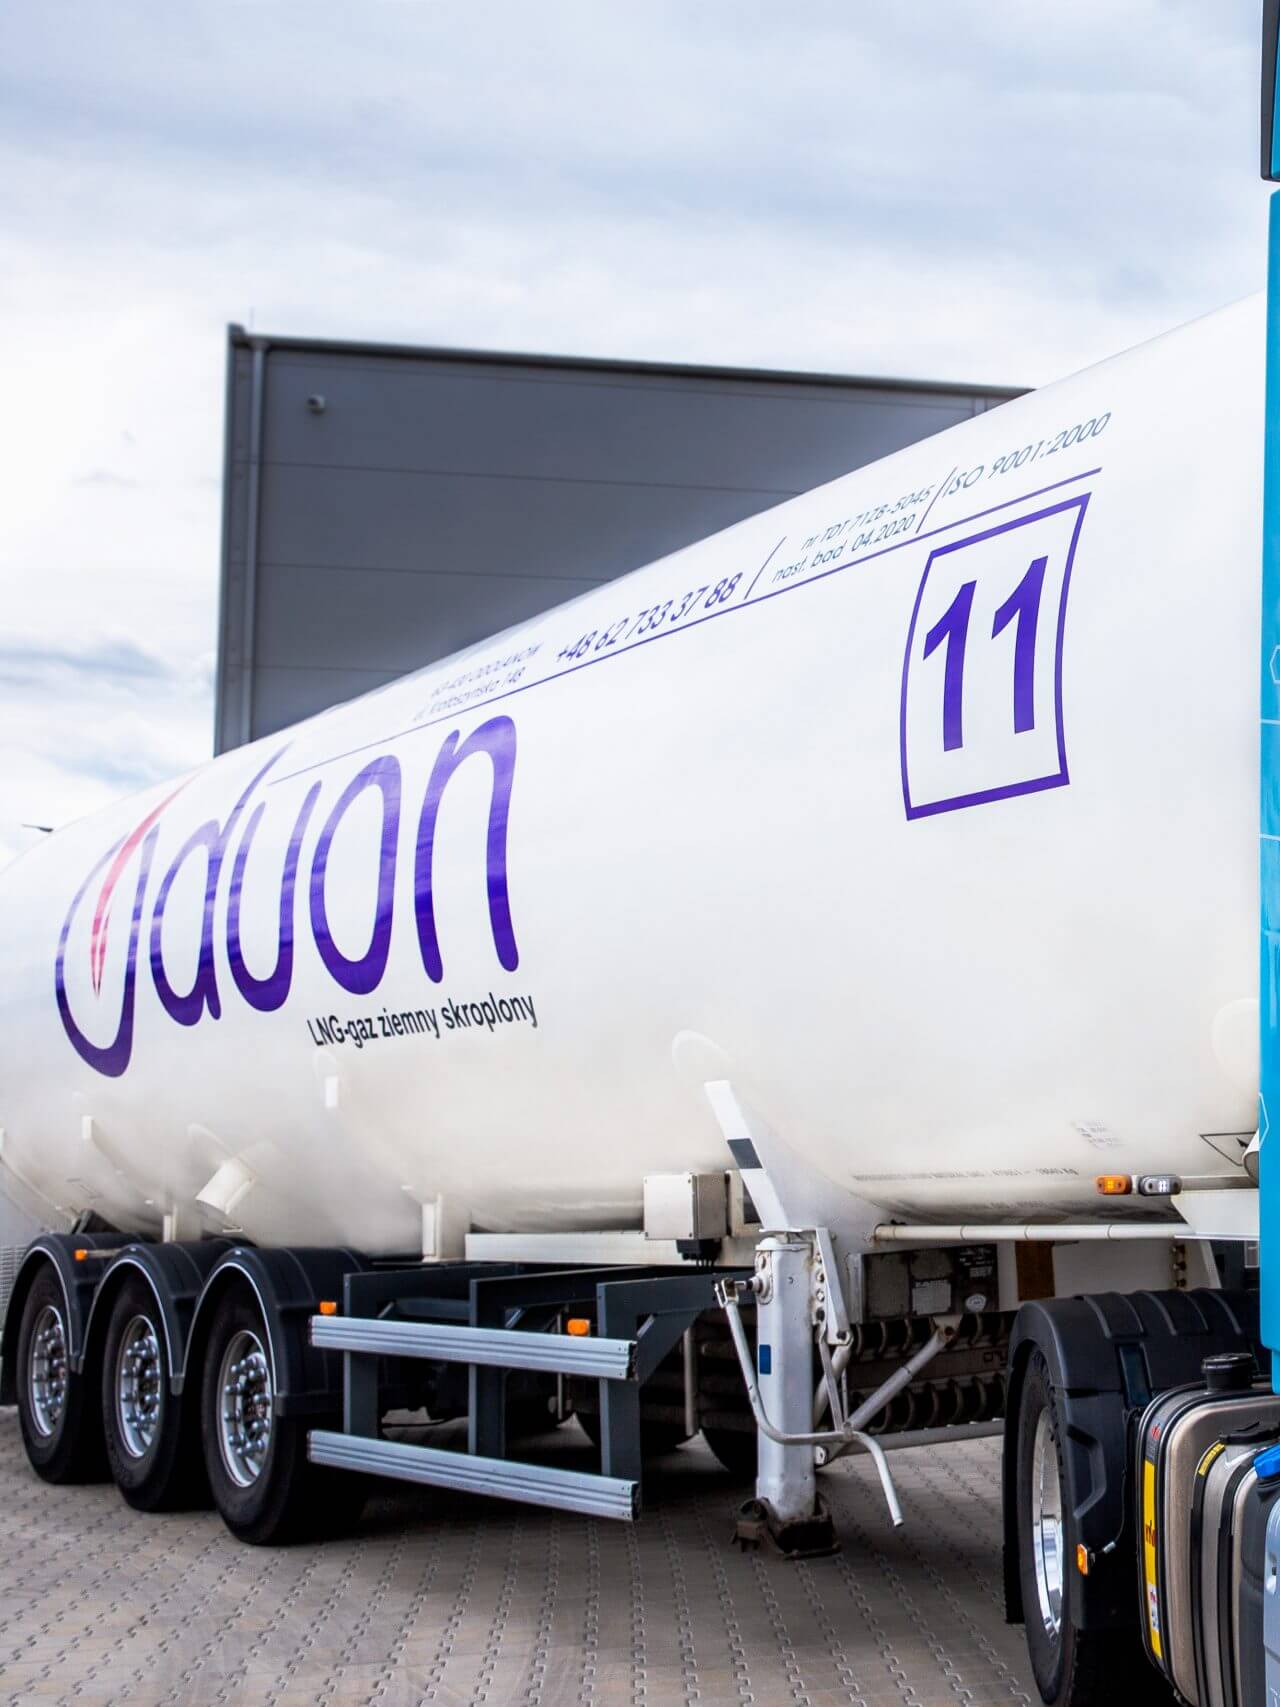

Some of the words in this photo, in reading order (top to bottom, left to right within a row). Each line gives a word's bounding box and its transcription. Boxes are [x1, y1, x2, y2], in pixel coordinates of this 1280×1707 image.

[942, 465, 984, 498] ISO
[988, 411, 1112, 479] 9001:2000
[851, 513, 916, 551] 04.2020
[556, 630, 598, 662] +48
[594, 616, 629, 650] 62
[625, 600, 673, 640] 733
[670, 585, 709, 621] 37
[704, 572, 743, 608] 88
[923, 555, 1049, 752] 11
[307, 1015, 379, 1048] LNG-gaz
[377, 1008, 440, 1039] ziemny
[441, 992, 538, 1033] skroplony
